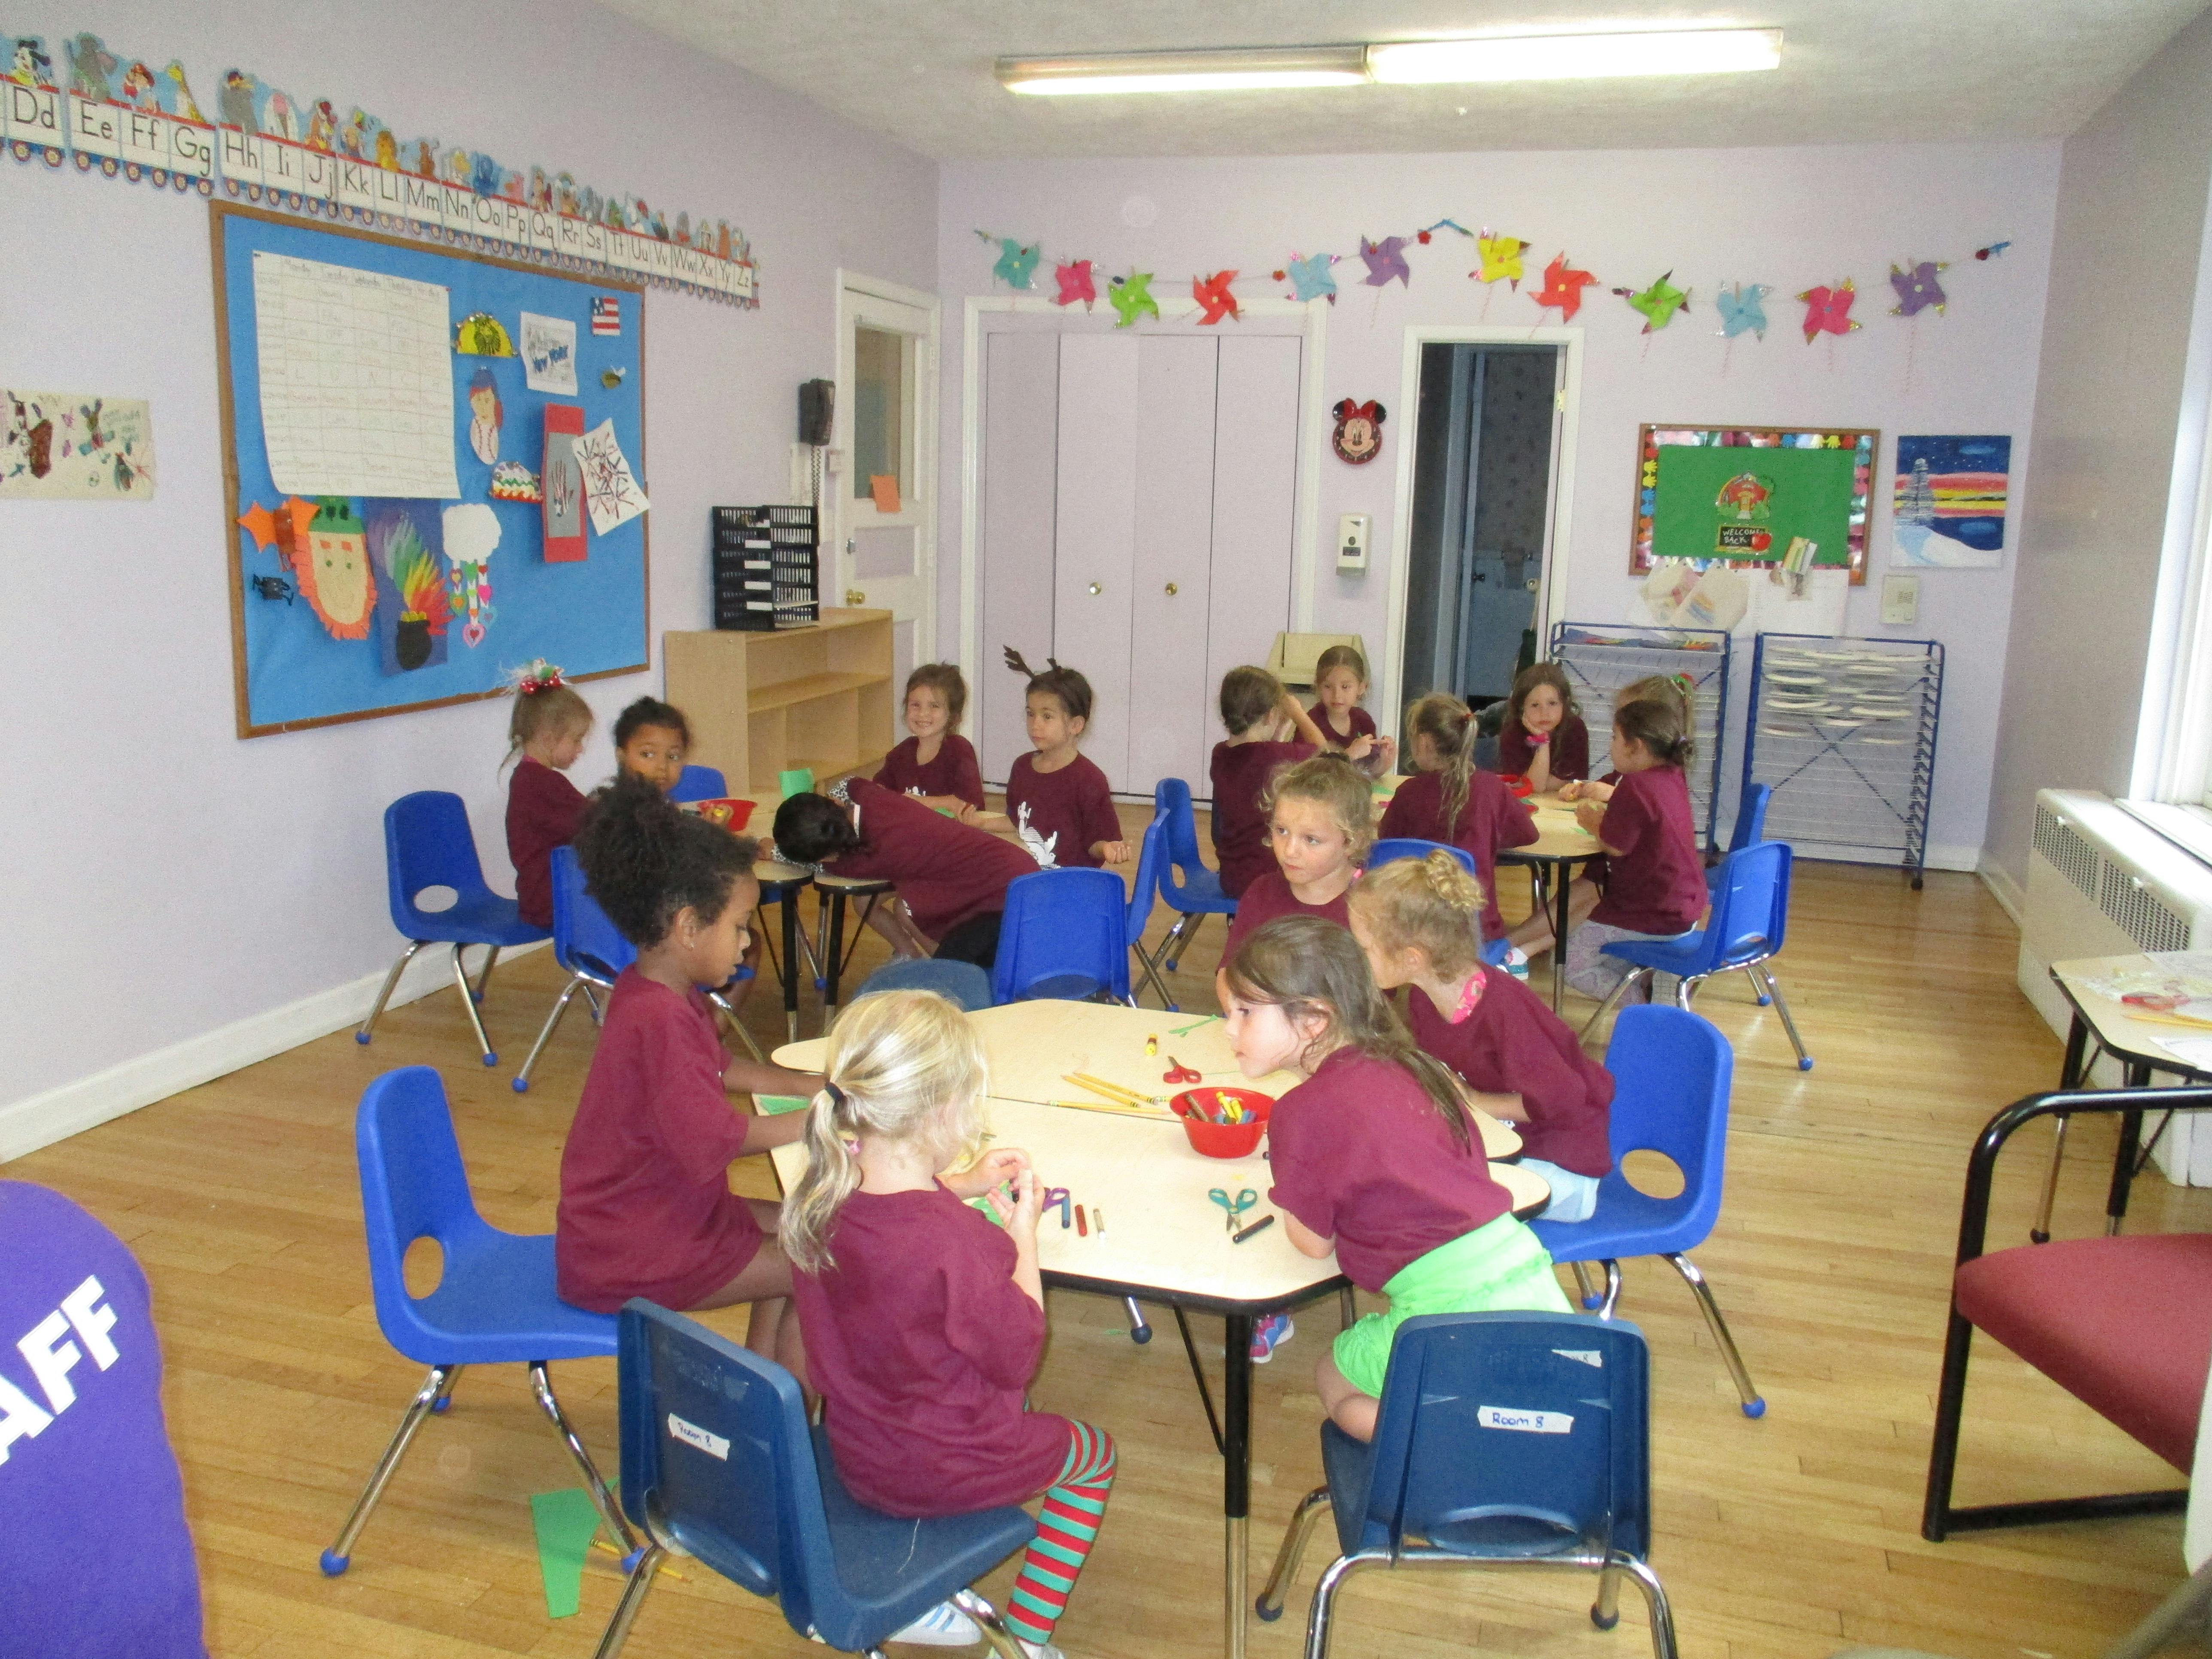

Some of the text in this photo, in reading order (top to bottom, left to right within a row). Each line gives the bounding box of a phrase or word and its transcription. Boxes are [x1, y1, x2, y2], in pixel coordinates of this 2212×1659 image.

[13, 87, 55, 129] Dd
[80, 101, 113, 140] Ee
[131, 115, 159, 150] Ff
[175, 127, 210, 176] Gg
[226, 131, 258, 170] Hh
[278, 145, 290, 176] Ii
[309, 154, 334, 199] Jj
[344, 162, 369, 195] Kk
[381, 171, 398, 202] Ll
[407, 178, 440, 212] Mm
[446, 188, 469, 219] Nn
[476, 198, 500, 226] Oo
[507, 205, 526, 243] Pp
[532, 213, 556, 250] Qq
[562, 218, 579, 244] Rr
[1492, 1412, 1544, 1428] Room 8
